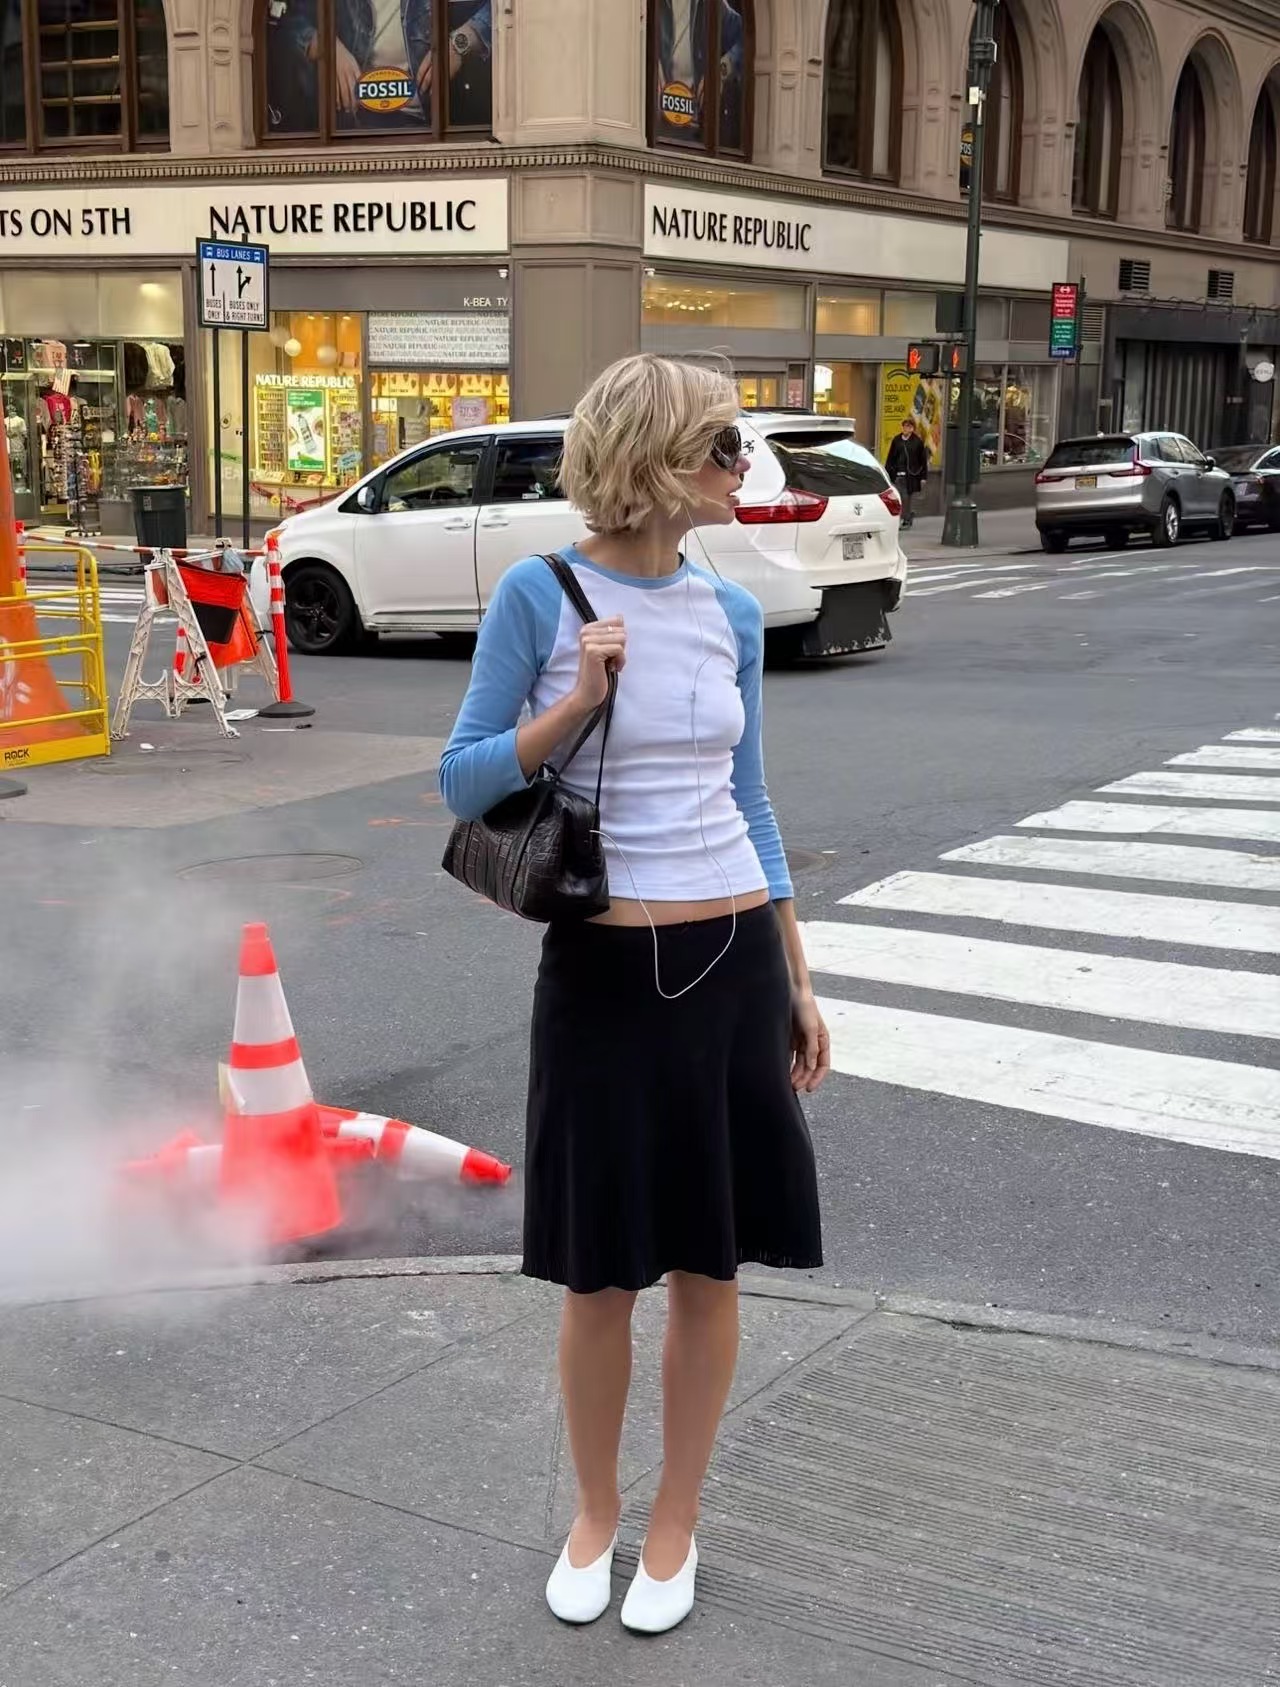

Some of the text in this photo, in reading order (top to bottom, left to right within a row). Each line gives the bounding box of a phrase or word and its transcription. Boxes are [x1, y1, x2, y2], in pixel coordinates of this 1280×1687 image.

[359, 81, 411, 98] FOSSIL
[662, 95, 695, 114] FOSSIL
[0, 207, 131, 237] TS ON 5TH
[209, 200, 477, 234] NATURE REPUBLIC
[652, 205, 812, 251] NATURE REPUBLIC
[216, 248, 251, 260] BUS LANES
[206, 298, 222, 309] BUSES
[229, 300, 260, 311] BUSES ONLY
[207, 310, 221, 320] ONLY
[231, 311, 247, 321] RIGHT
[247, 312, 264, 322] TURNS
[255, 374, 355, 389] NATURE REPUBLIC
[4, 748, 30, 760] ROCK
